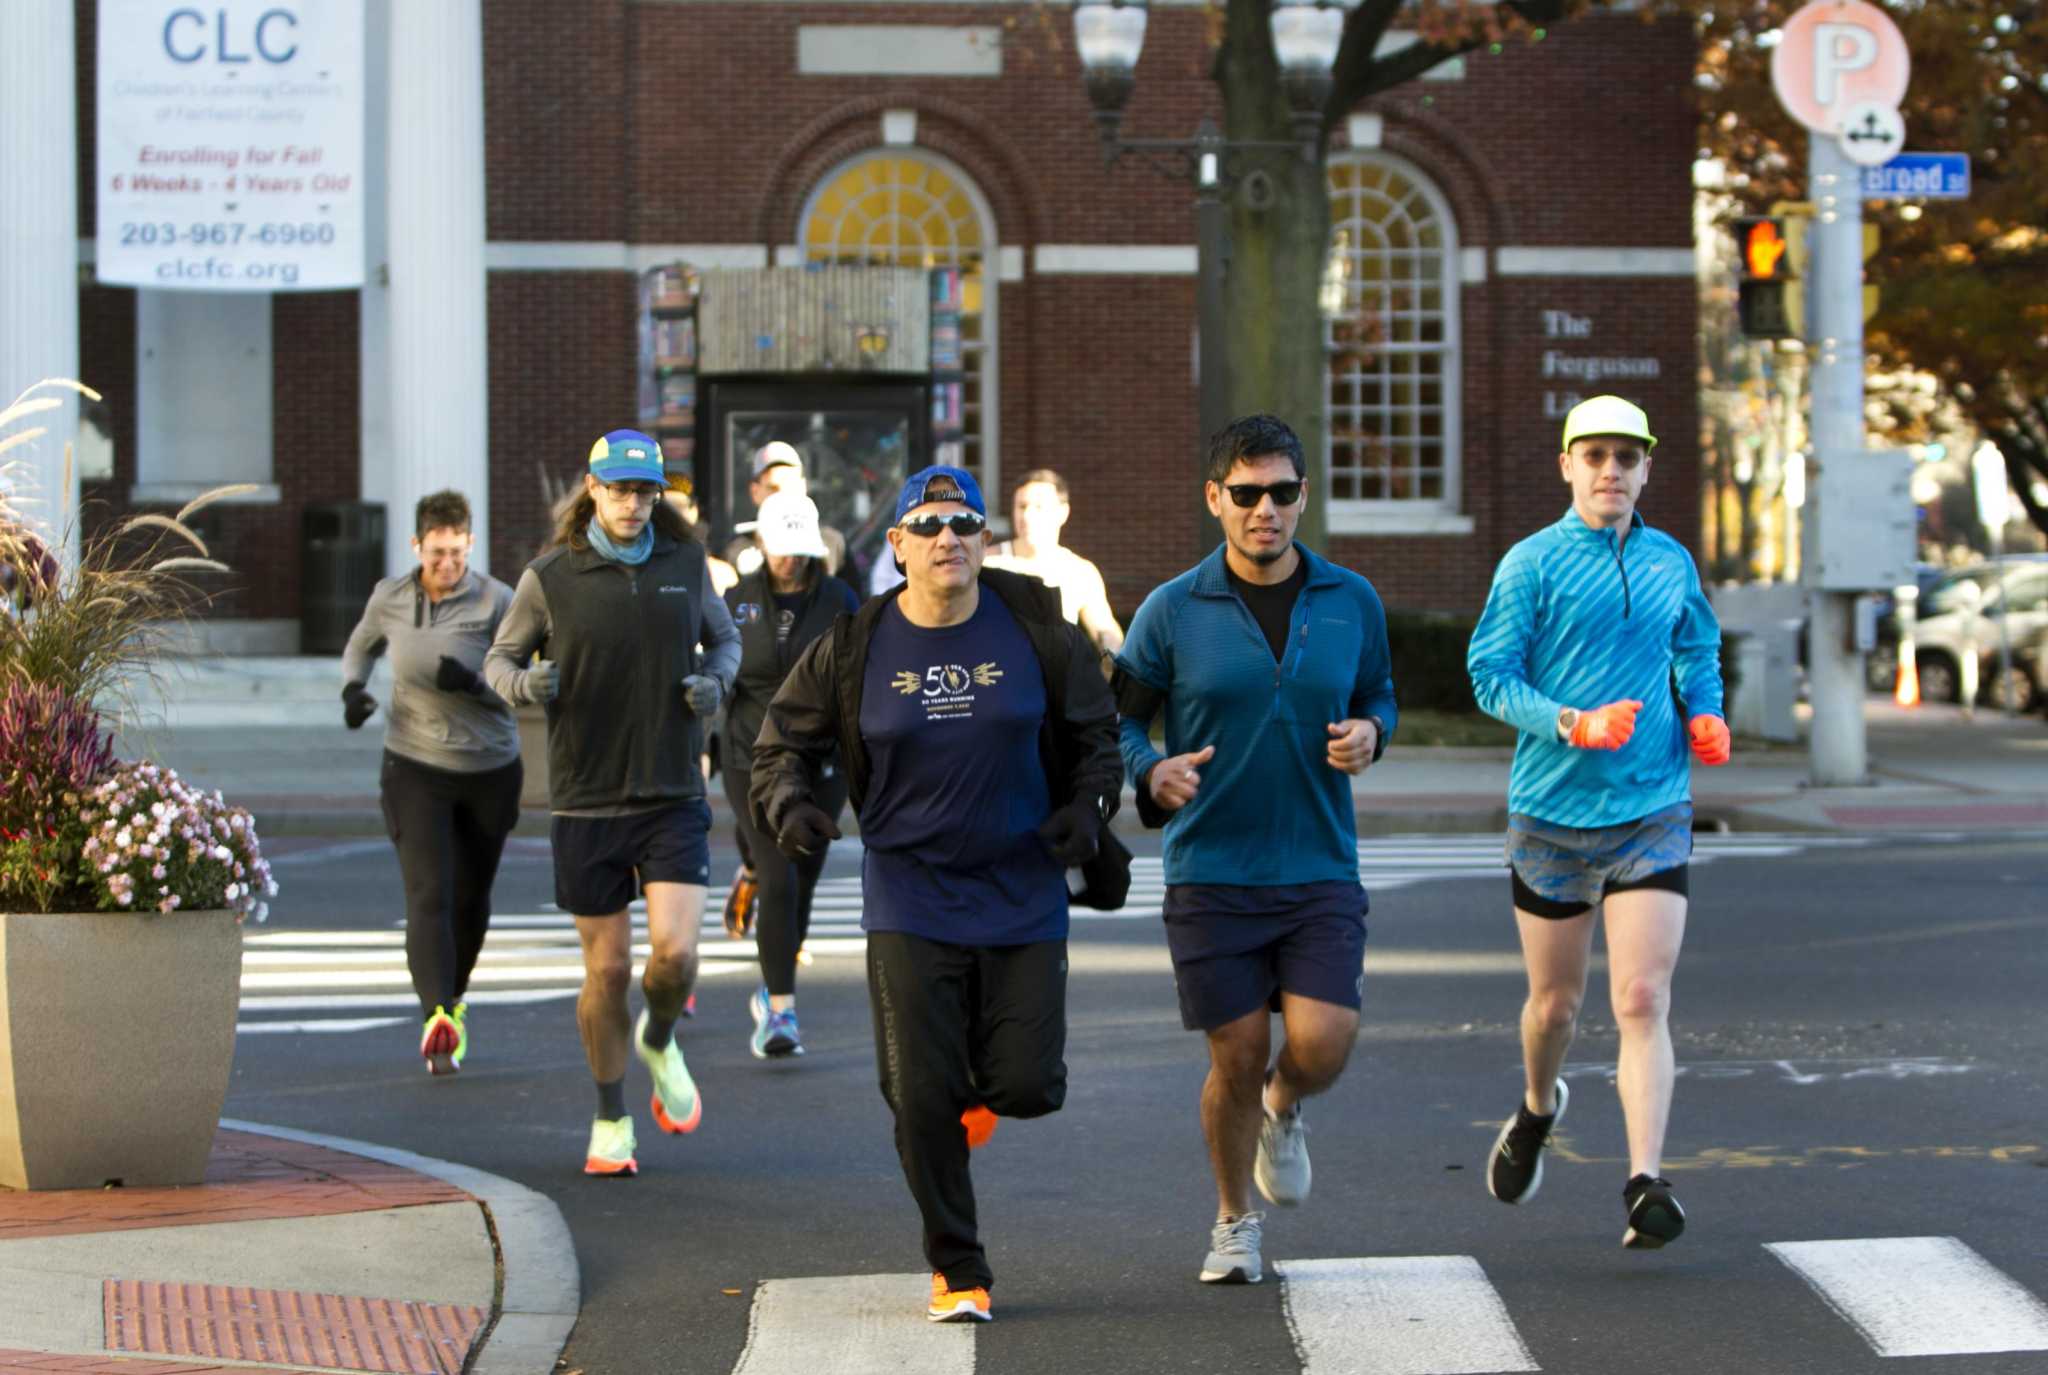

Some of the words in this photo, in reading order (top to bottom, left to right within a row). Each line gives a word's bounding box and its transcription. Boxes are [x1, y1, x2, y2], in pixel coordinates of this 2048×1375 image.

[162, 8, 299, 64] CLC
[1814, 23, 1878, 105] P
[138, 145, 239, 167] Enrolling
[246, 145, 275, 164] for
[282, 145, 323, 164] Fall
[112, 174, 124, 192] 6
[132, 174, 203, 192] Weeks
[225, 174, 237, 192] 4
[246, 174, 303, 192] Years
[312, 174, 352, 192] Old
[1866, 165, 1942, 191] Broad
[120, 222, 335, 246] 203-967-6960
[156, 257, 299, 283] clcfc.org
[1543, 310, 1592, 337] The
[1543, 350, 1661, 384] Ferguson
